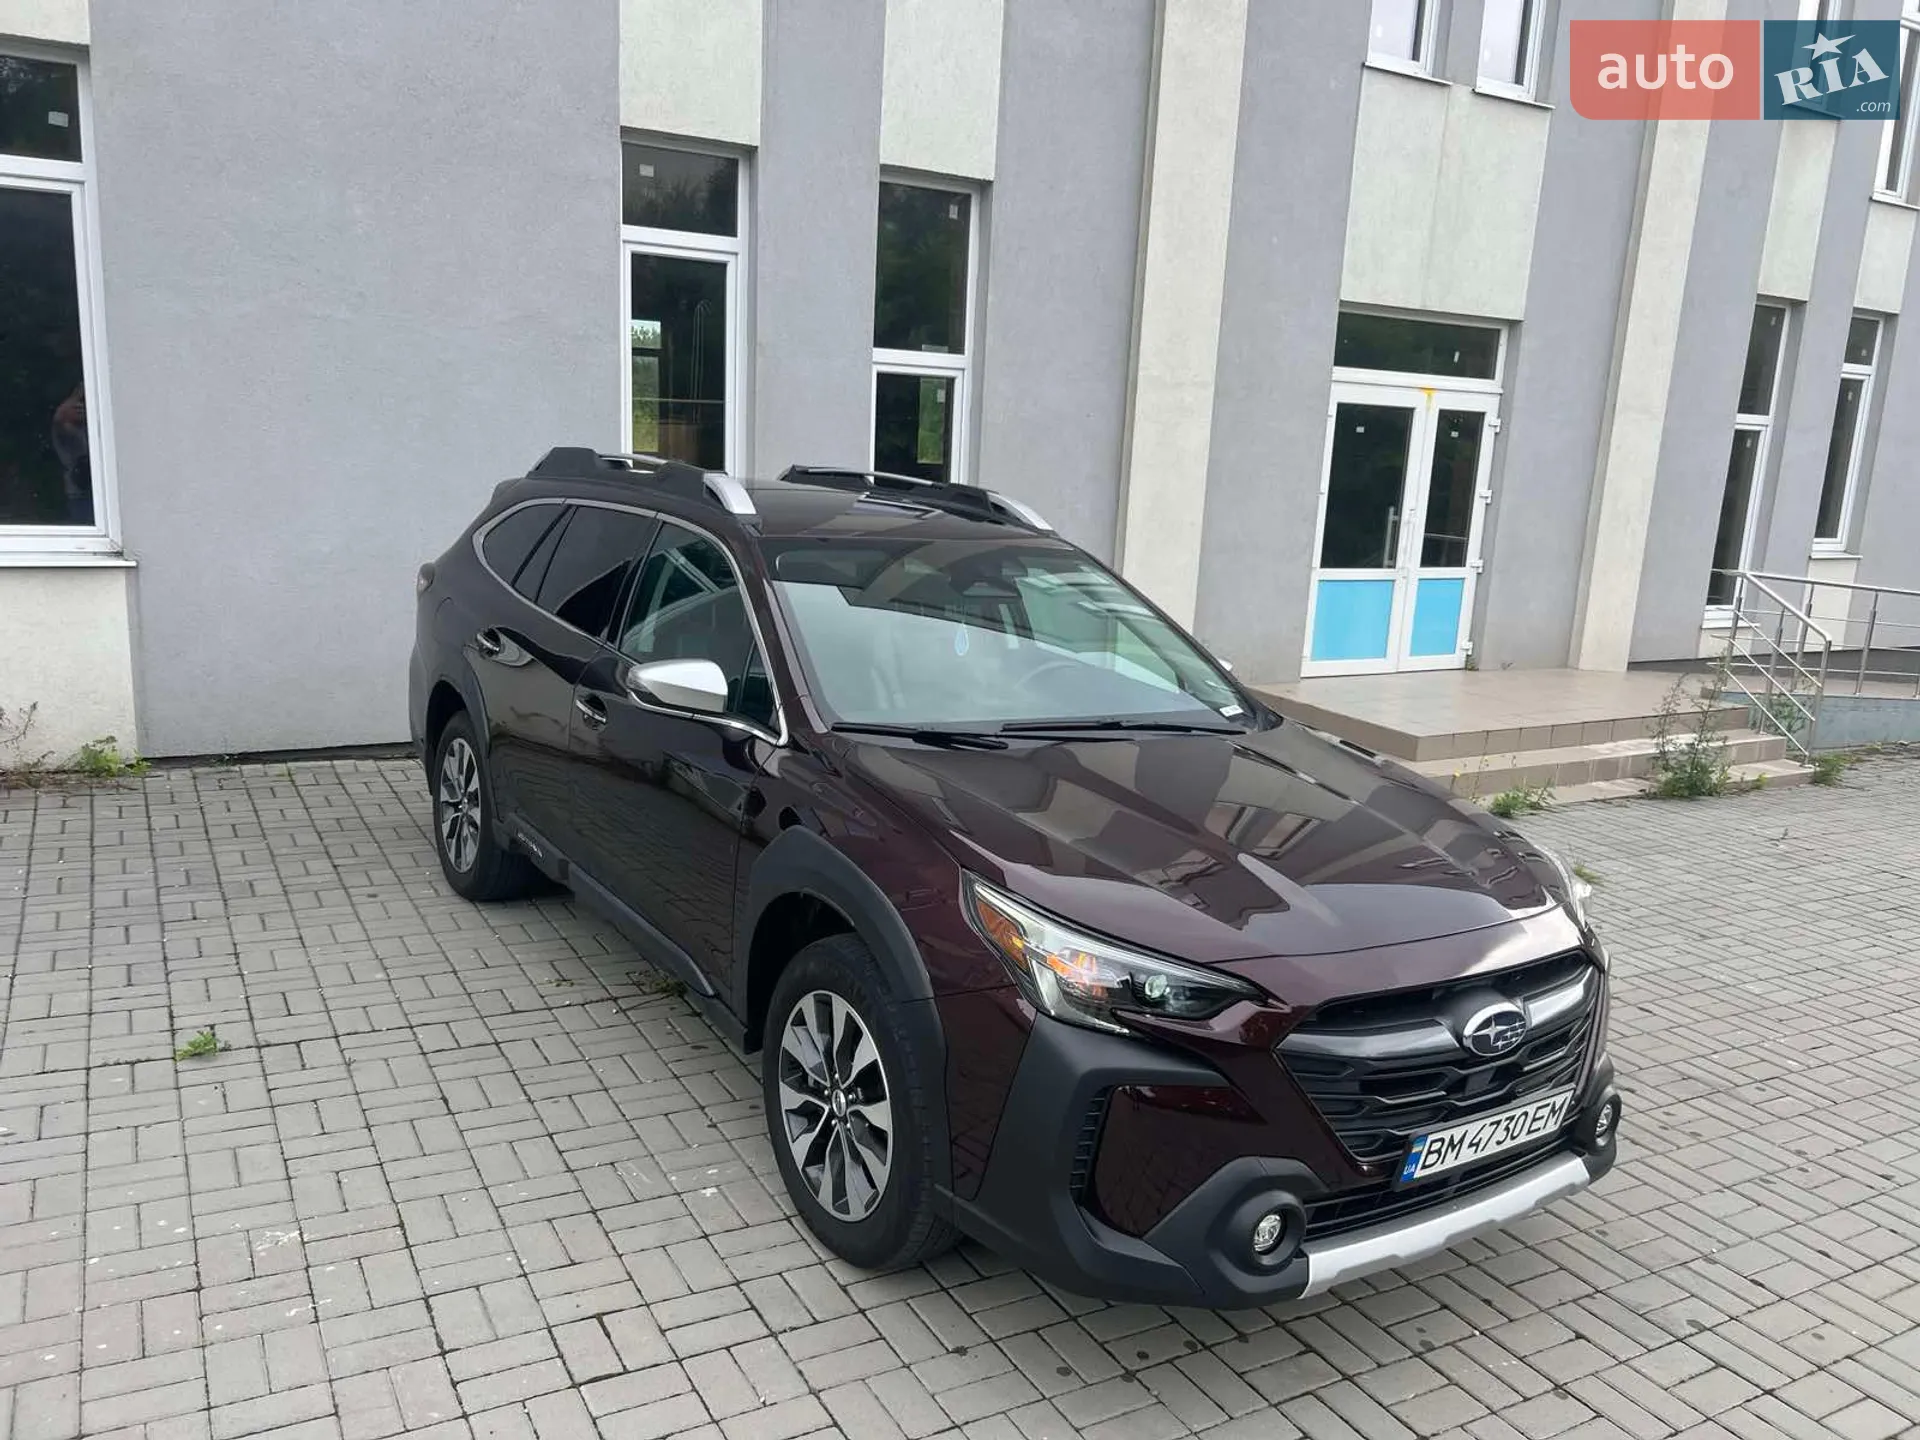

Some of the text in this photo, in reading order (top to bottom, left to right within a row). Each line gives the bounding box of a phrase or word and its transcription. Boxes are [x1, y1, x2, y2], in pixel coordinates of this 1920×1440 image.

[1420, 1097, 1567, 1170] BM 4730 EM
